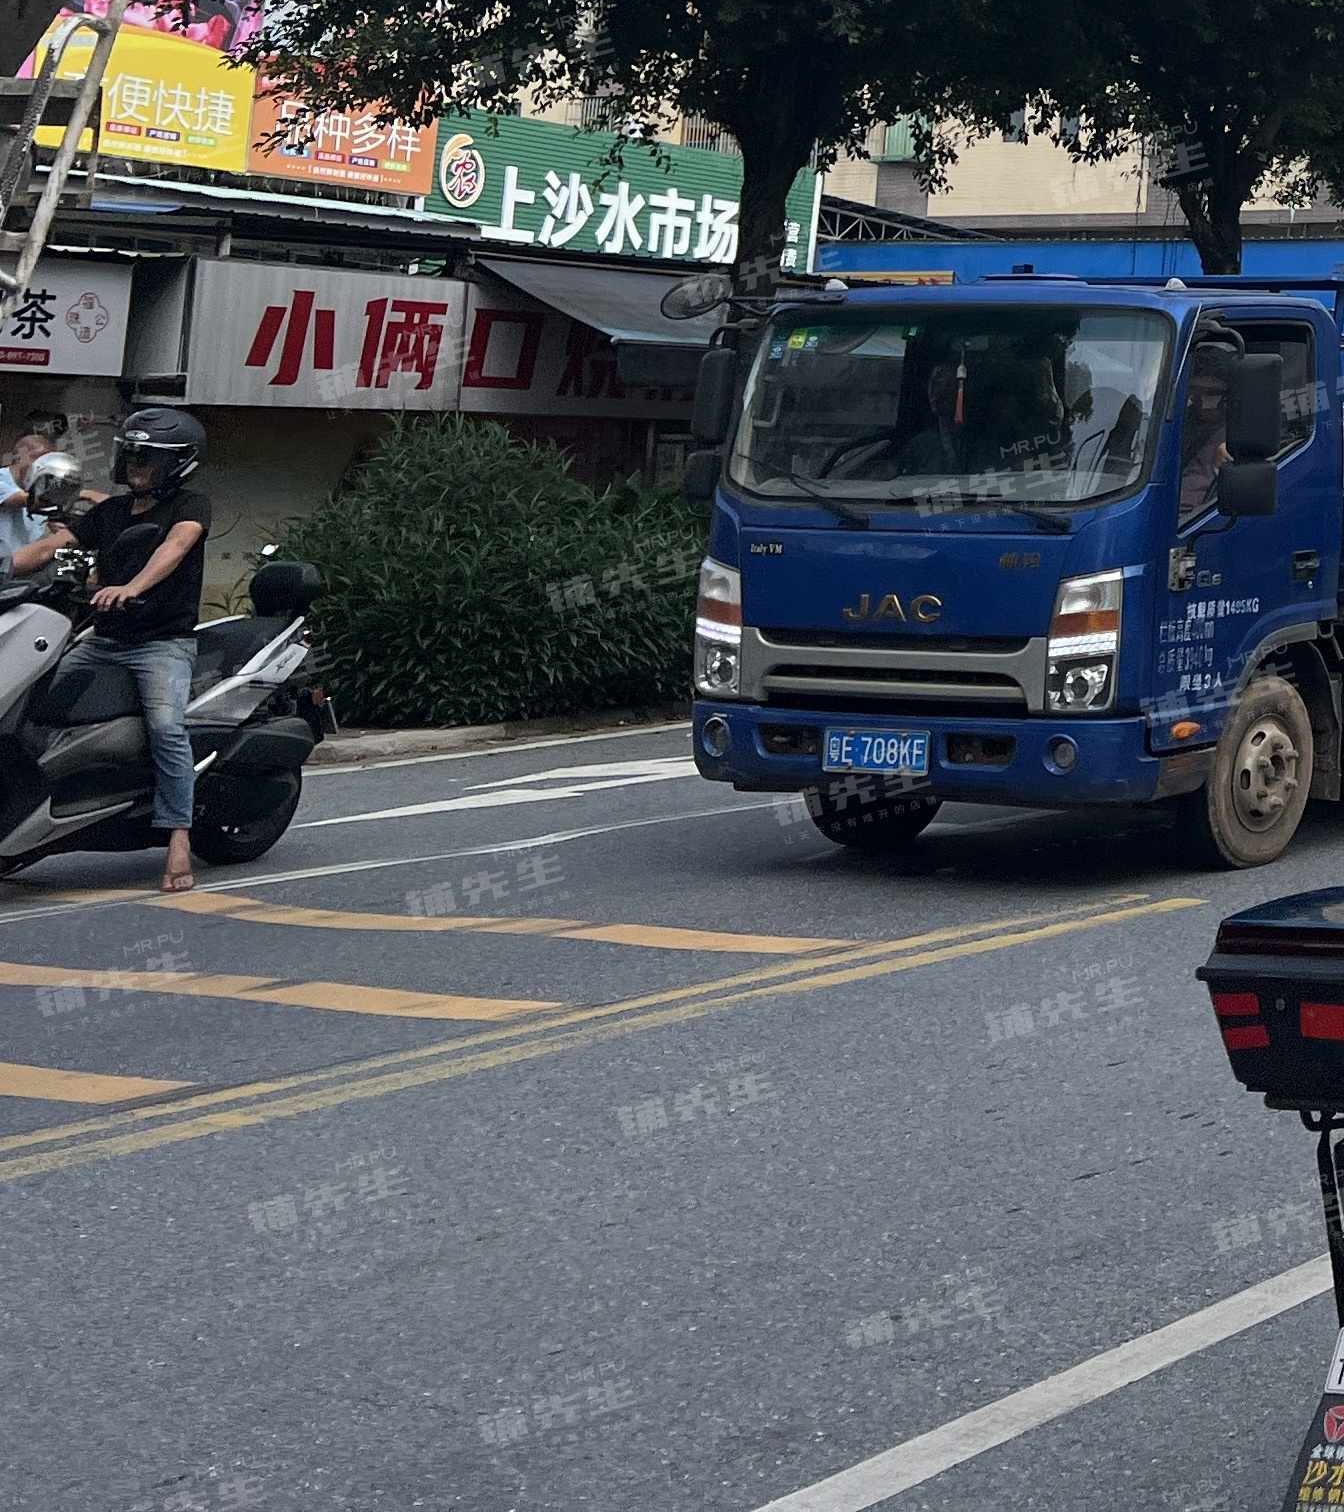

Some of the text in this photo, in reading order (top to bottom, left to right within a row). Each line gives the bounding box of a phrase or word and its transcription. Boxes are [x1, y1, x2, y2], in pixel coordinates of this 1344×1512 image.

[480, 164, 740, 265] 上沙水市场
[0, 288, 57, 340] 茶
[843, 593, 944, 624] JAC
